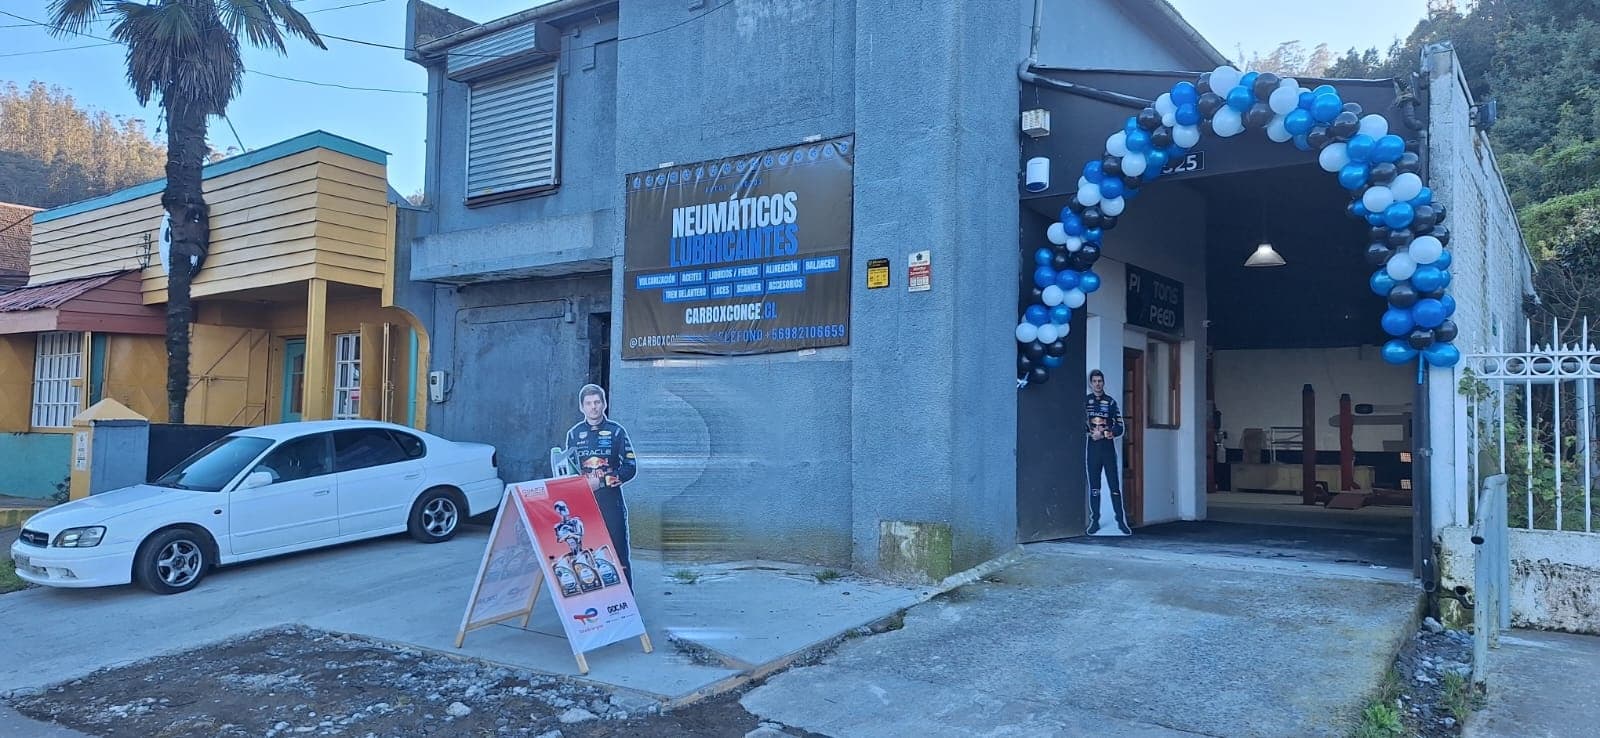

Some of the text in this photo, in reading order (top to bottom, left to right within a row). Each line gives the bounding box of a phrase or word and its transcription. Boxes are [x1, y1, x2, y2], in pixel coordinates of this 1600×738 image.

[1162, 154, 1197, 173] 25
[672, 192, 798, 238] NEUMÁTICOS
[670, 224, 799, 267] LUBRICANTES
[765, 261, 798, 274] ALINEACIÓN
[713, 285, 730, 295] LUCES
[767, 278, 803, 290] ACCESORIOS
[685, 301, 778, 325] CARBOXCONCE.CL
